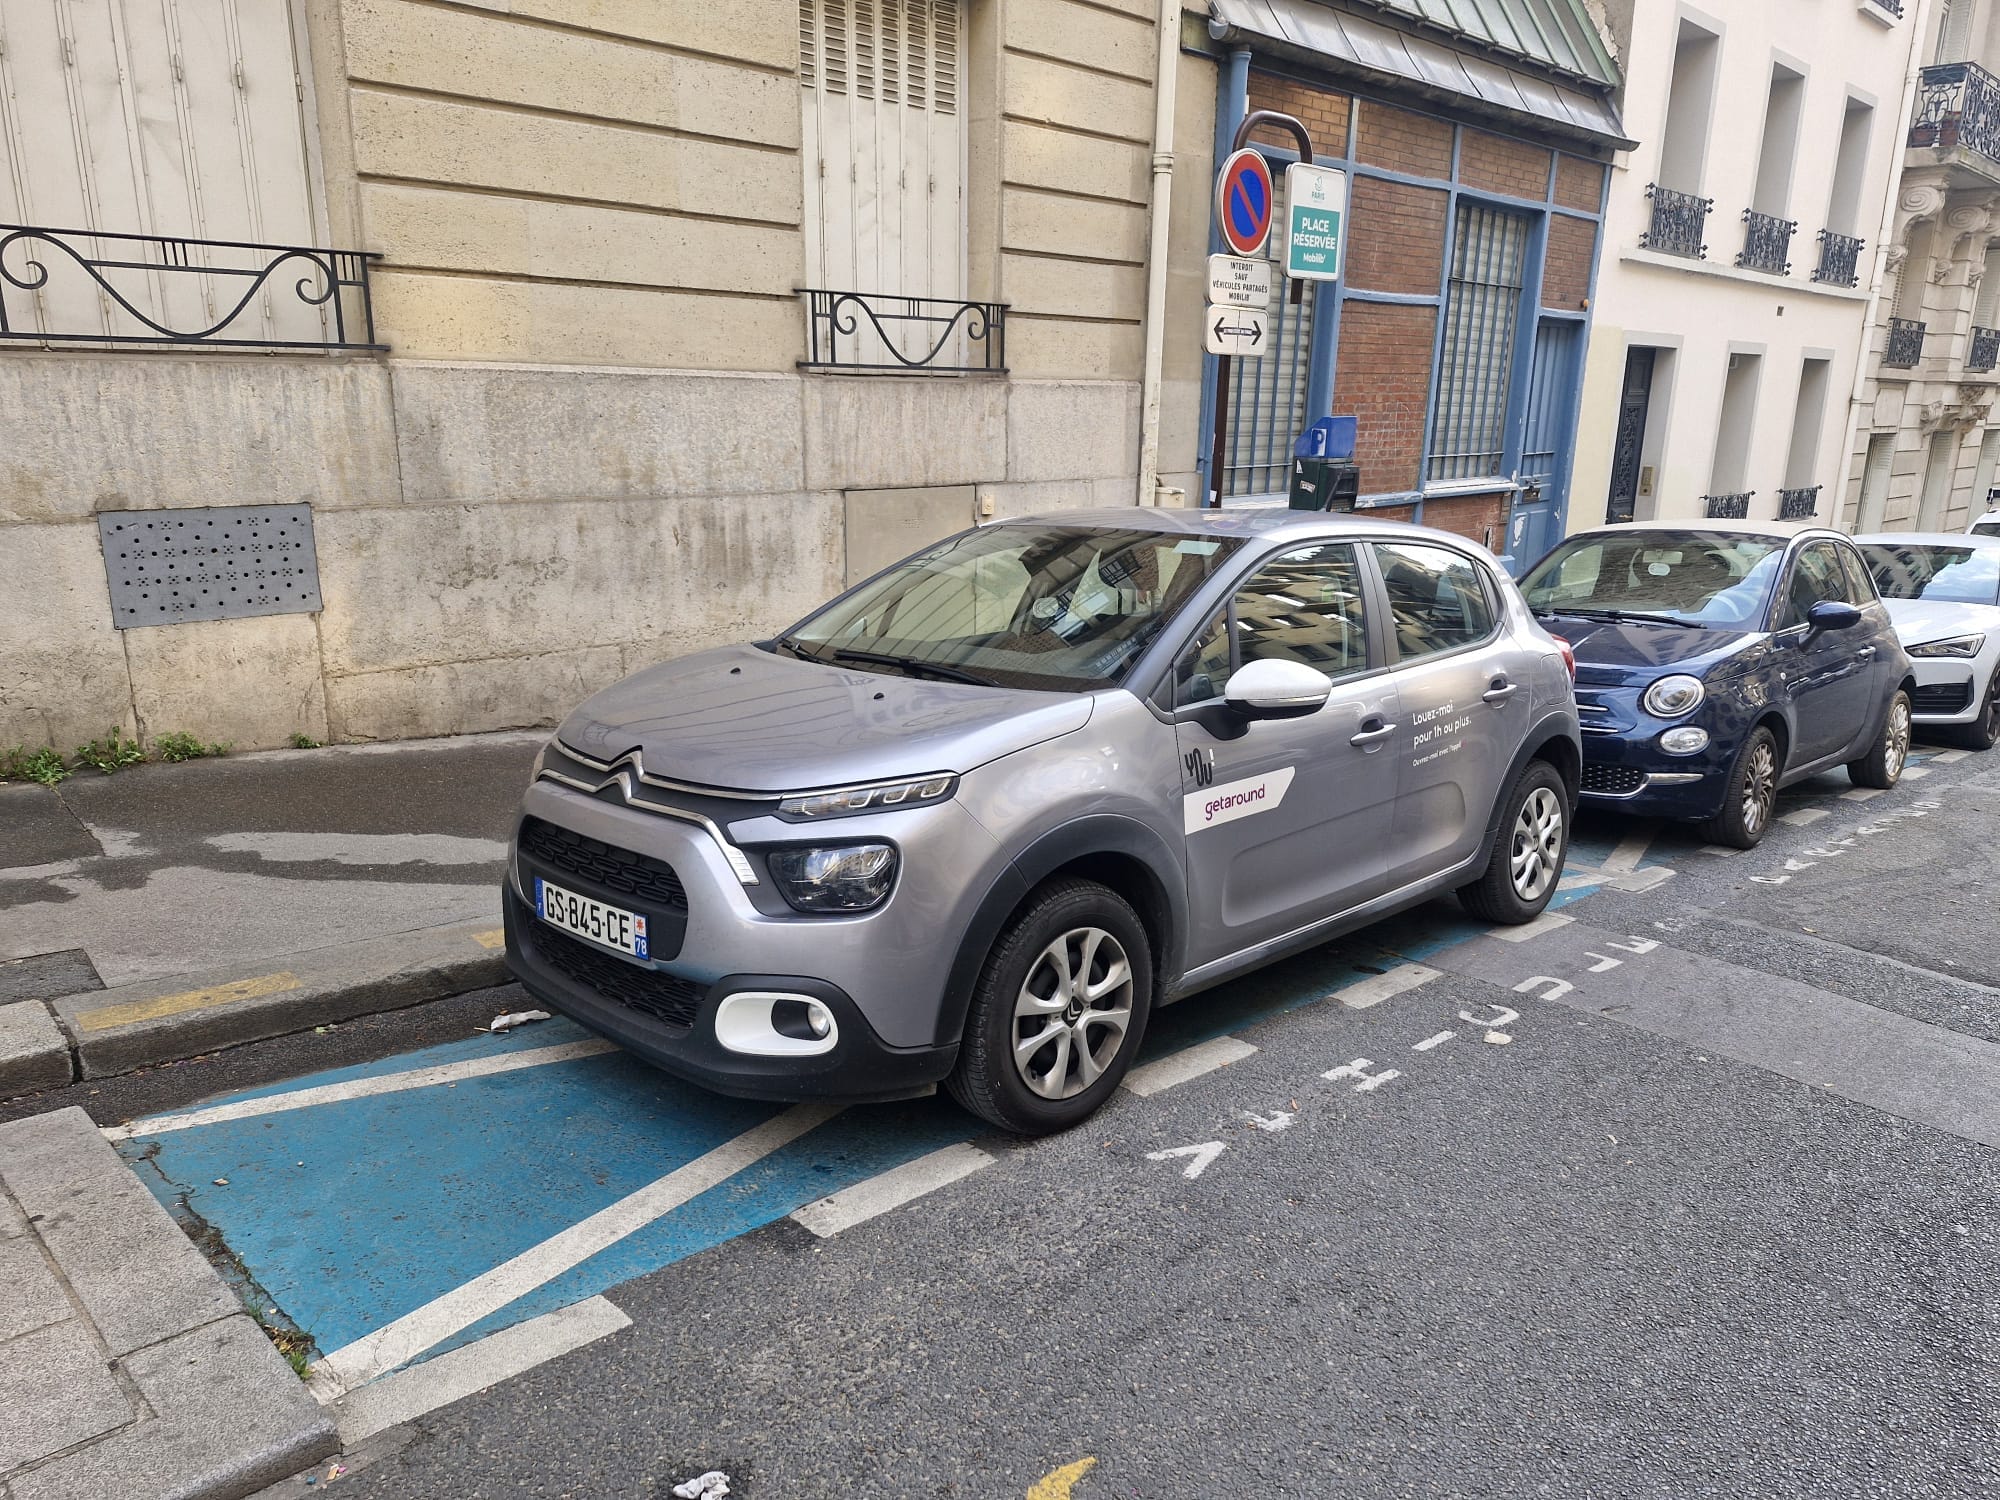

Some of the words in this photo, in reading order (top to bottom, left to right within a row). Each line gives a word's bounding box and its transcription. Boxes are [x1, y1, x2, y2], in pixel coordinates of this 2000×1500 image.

[1311, 191, 1325, 201] PARIS
[1302, 217, 1330, 233] PLACE
[1293, 231, 1336, 250] RÉSERVÉE
[1230, 261, 1254, 272] INTERDIT
[1234, 273, 1248, 281] SAUF
[1212, 279, 1241, 291] VÉHICULES
[1242, 284, 1268, 294] PARTAGÉS
[1412, 699, 1454, 726] Louez-moi
[1413, 730, 1433, 751] pour
[1433, 724, 1442, 738] 1h
[1443, 722, 1453, 734] ou
[1454, 715, 1472, 734] plus.
[1205, 783, 1265, 821] getaround
[545, 886, 632, 949] GS-845-CE
[635, 937, 647, 955] 78
